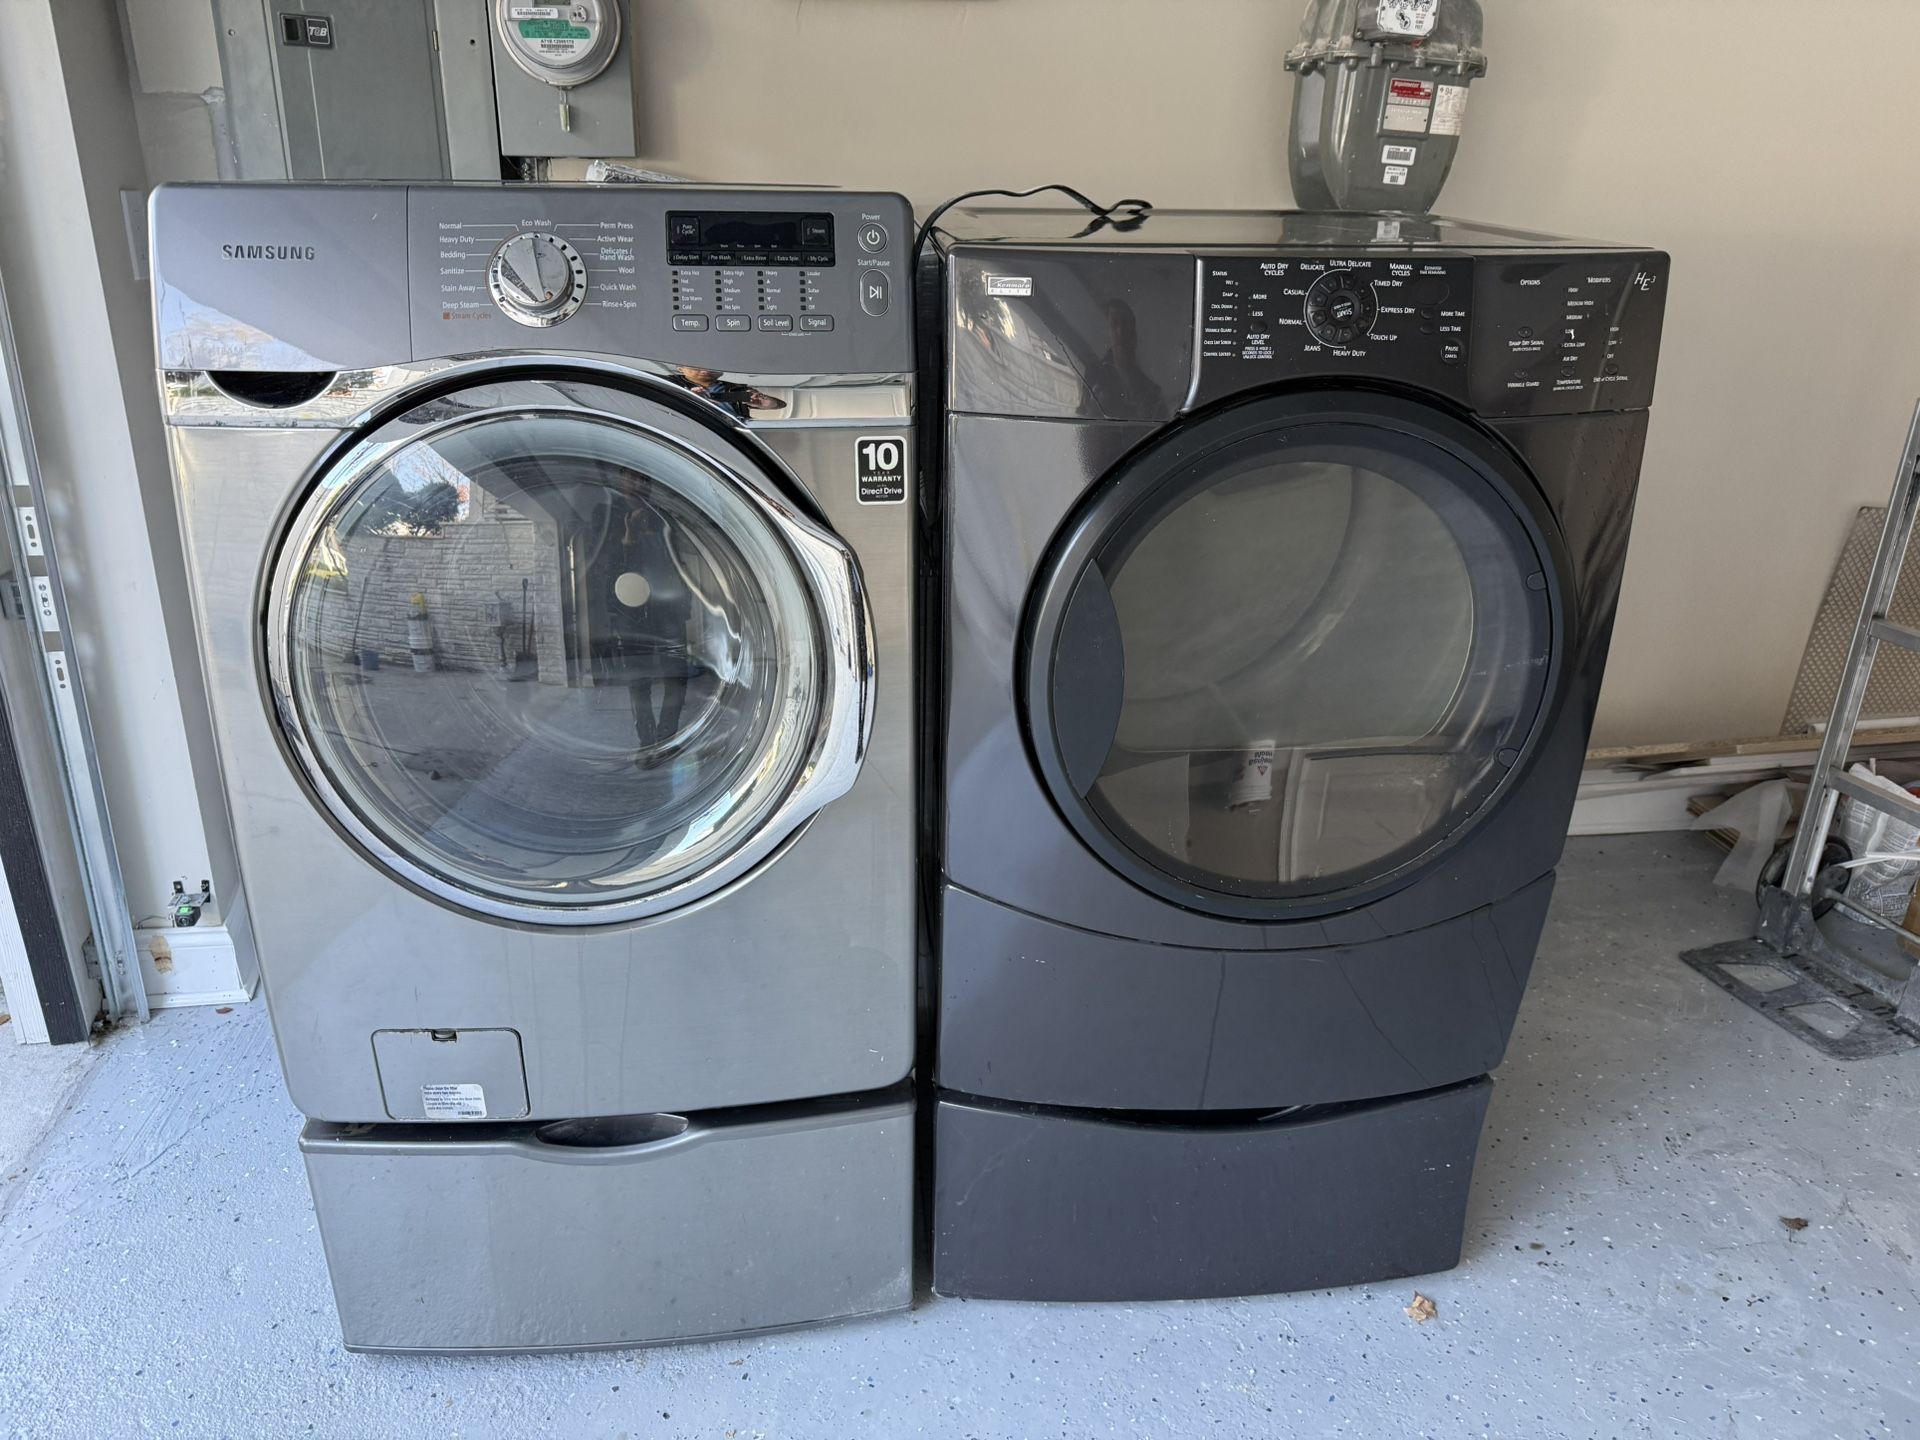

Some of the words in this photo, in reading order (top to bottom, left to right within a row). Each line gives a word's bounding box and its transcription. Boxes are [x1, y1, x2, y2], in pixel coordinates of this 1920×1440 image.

[222, 244, 314, 260] SAMSUNG
[472, 312, 492, 320] Cycles
[681, 319, 701, 327] Temp.
[727, 319, 740, 327] Spin
[808, 318, 826, 327] Signal
[862, 442, 899, 470] 10
